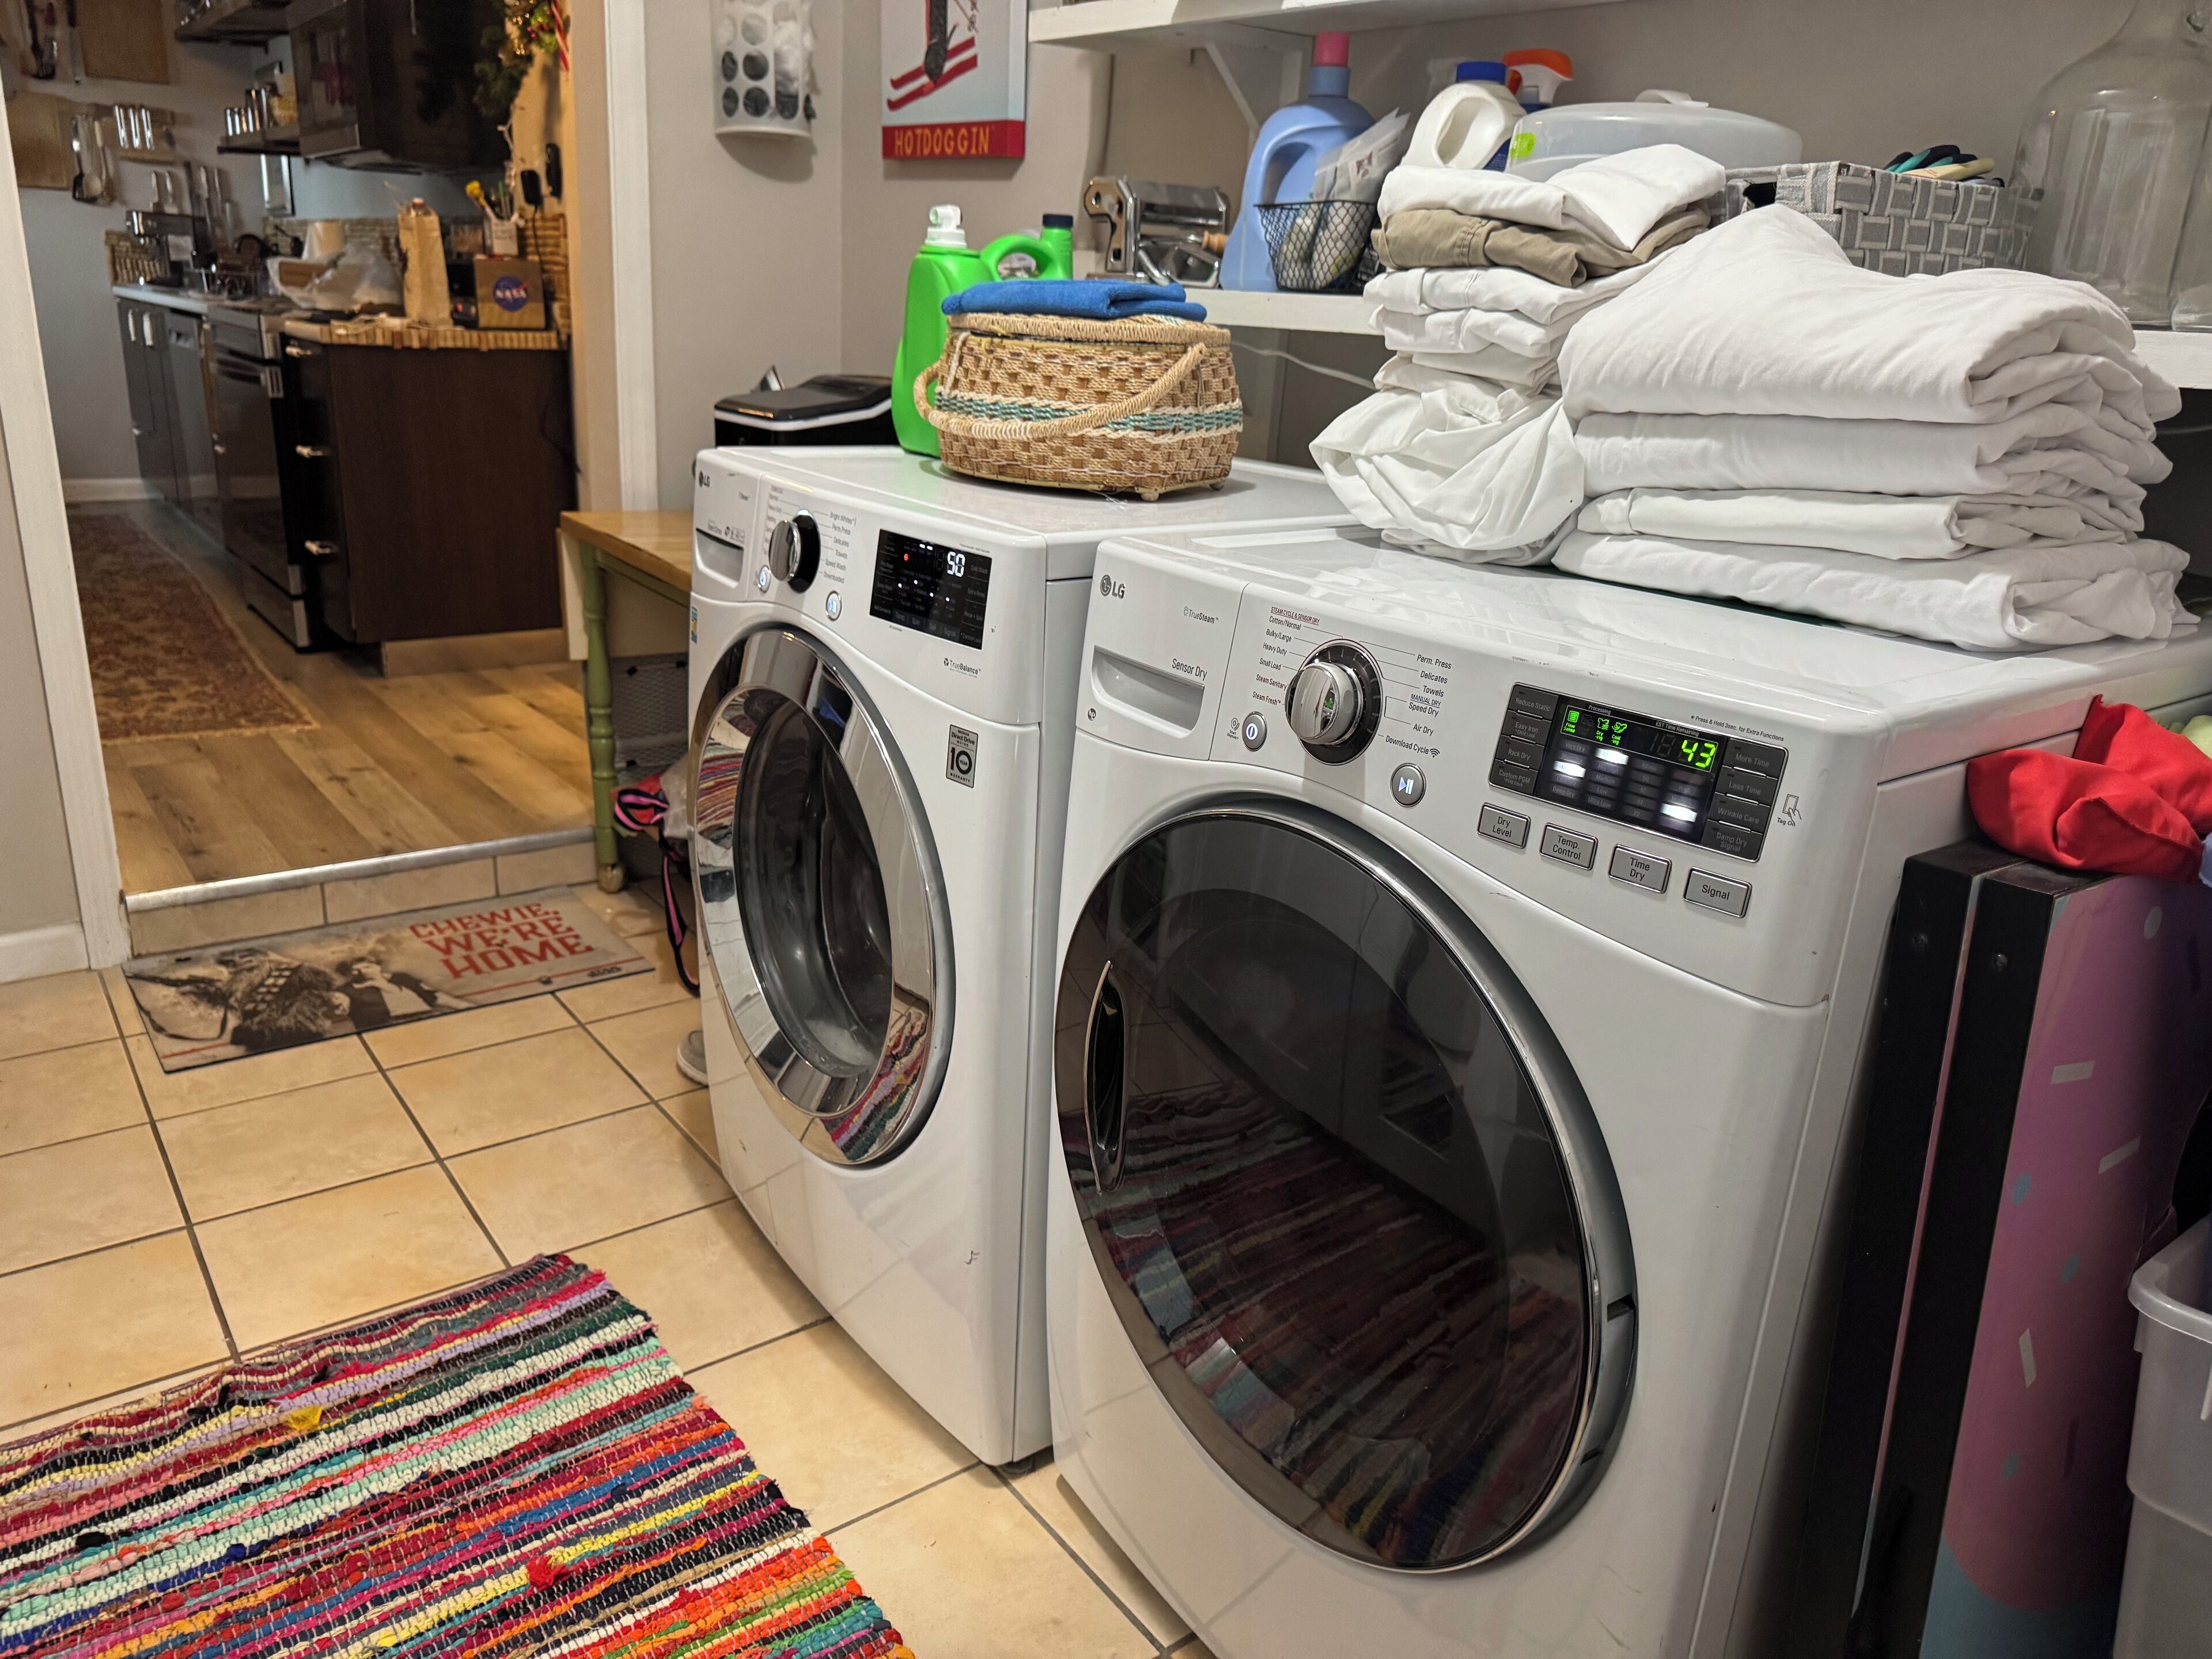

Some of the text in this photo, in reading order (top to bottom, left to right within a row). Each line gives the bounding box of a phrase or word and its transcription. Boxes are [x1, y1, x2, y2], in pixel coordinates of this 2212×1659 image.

[895, 126, 989, 156] HOTDOGGIN
[834, 537, 849, 547] Delicates
[836, 549, 848, 559] Towels
[825, 559, 846, 571] Speed Wash
[947, 551, 965, 577] 50
[824, 570, 844, 584] Downloaded
[1112, 581, 1125, 599] LG
[1269, 616, 1301, 630] Cotton/Normal
[1298, 613, 1312, 622] SENSOR
[1266, 628, 1291, 642] Bulky/Large
[1263, 642, 1287, 656] Heavy Duty
[1260, 658, 1282, 670] Small Load
[1416, 654, 1452, 669] Perm. Press
[1172, 658, 1207, 680] Sensor Dry
[1256, 674, 1268, 684] Steam
[1421, 671, 1448, 684] Delicates
[1252, 691, 1266, 701] Steam
[1423, 685, 1444, 698] Towels
[1411, 694, 1441, 707] MANUAL DRY
[1516, 698, 1551, 711] Reduce Static
[1409, 702, 1439, 718] Speed Dry
[1589, 704, 1611, 715] Processing
[1413, 724, 1434, 737] Air Dry
[1515, 722, 1539, 733] Easy Iron
[1676, 726, 1699, 737] Remaining
[1714, 720, 1724, 728] Hold
[1747, 728, 1759, 736] Extra
[1760, 730, 1784, 741] Functions
[952, 732, 975, 745] Direct Drive
[1386, 735, 1429, 754] Download Cycle
[1508, 749, 1531, 761] Rack Dry
[1681, 740, 1715, 768] 43
[1735, 753, 1770, 768] More Time
[951, 747, 972, 775] 10
[950, 772, 969, 782] WARRANTY
[1499, 770, 1531, 784] Custom PGM
[1596, 774, 1615, 784] Medium
[1729, 781, 1762, 795] Less Time
[1498, 816, 1510, 828] Dry
[1718, 807, 1759, 824] Wrinkle Care
[1777, 817, 1786, 825] Tag
[1493, 825, 1512, 838] Level
[1558, 835, 1580, 850] Temp.
[1717, 832, 1748, 848] Damp Dry
[1553, 844, 1581, 860] Control
[1721, 842, 1741, 852] Signal
[1630, 858, 1650, 871] Time
[1630, 869, 1645, 881] Dry
[1702, 885, 1730, 900] Signal
[423, 916, 575, 956] WE'RE
[441, 934, 593, 979] HOME
